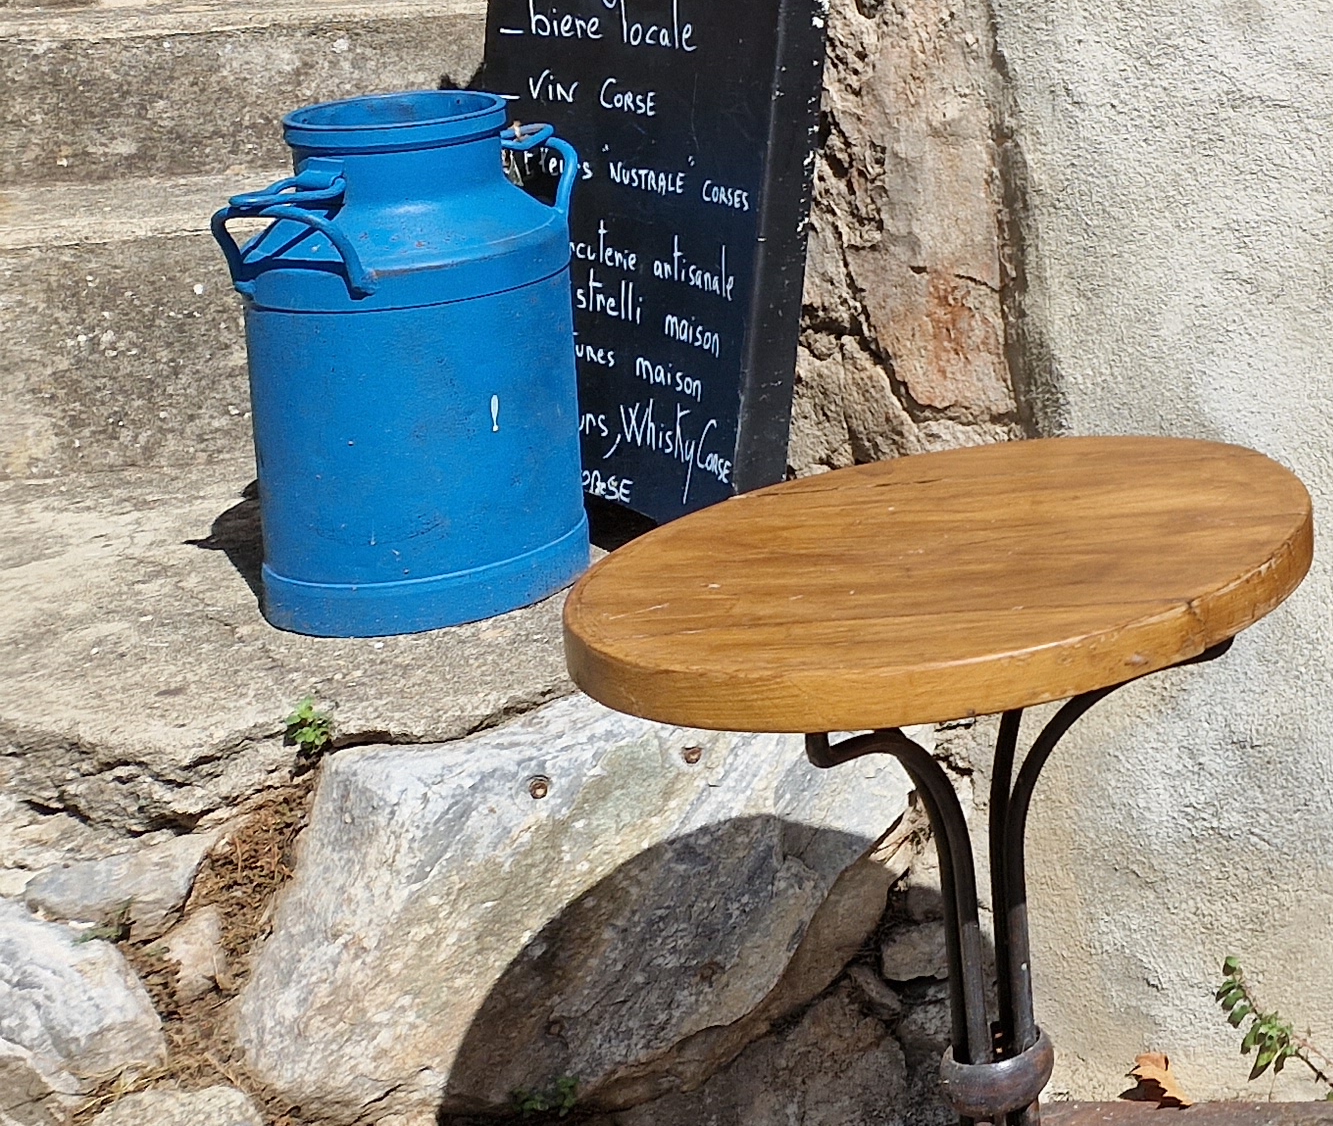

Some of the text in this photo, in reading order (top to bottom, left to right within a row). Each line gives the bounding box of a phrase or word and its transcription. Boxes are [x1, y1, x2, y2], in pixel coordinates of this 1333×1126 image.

[600, 78, 657, 117] CORSE
[702, 179, 750, 212] CORSES
[664, 313, 721, 358] maison
[635, 356, 703, 402] maison
